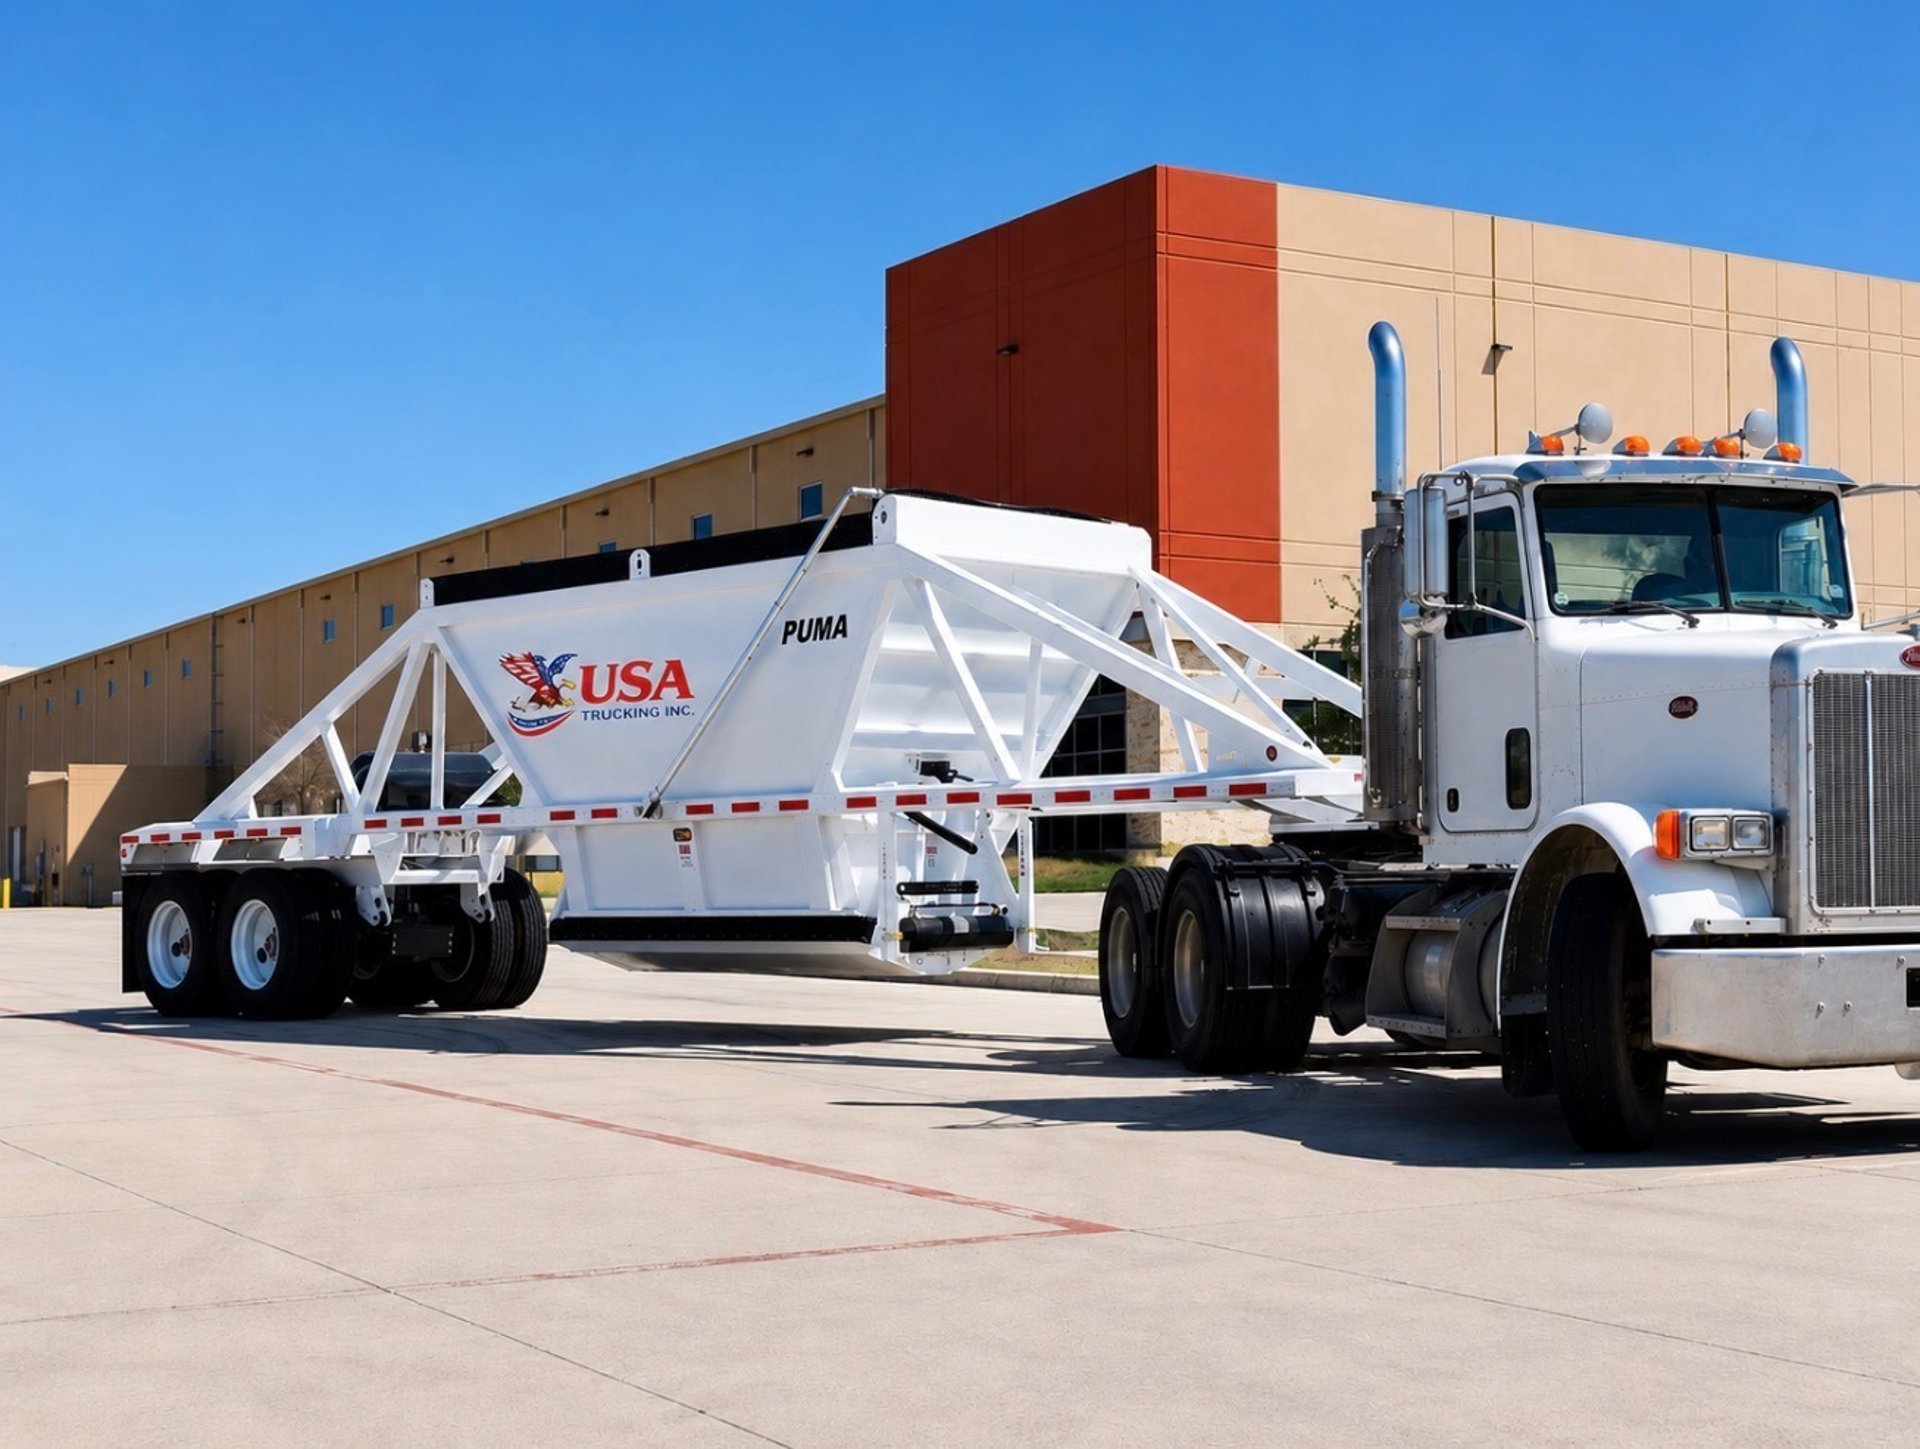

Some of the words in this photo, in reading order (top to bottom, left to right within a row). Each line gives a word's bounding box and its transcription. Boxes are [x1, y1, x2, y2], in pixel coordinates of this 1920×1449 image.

[782, 614, 847, 645] PUMA
[580, 659, 695, 704] USA
[581, 707, 660, 721] TRUCKING
[665, 705, 695, 717] INC.
